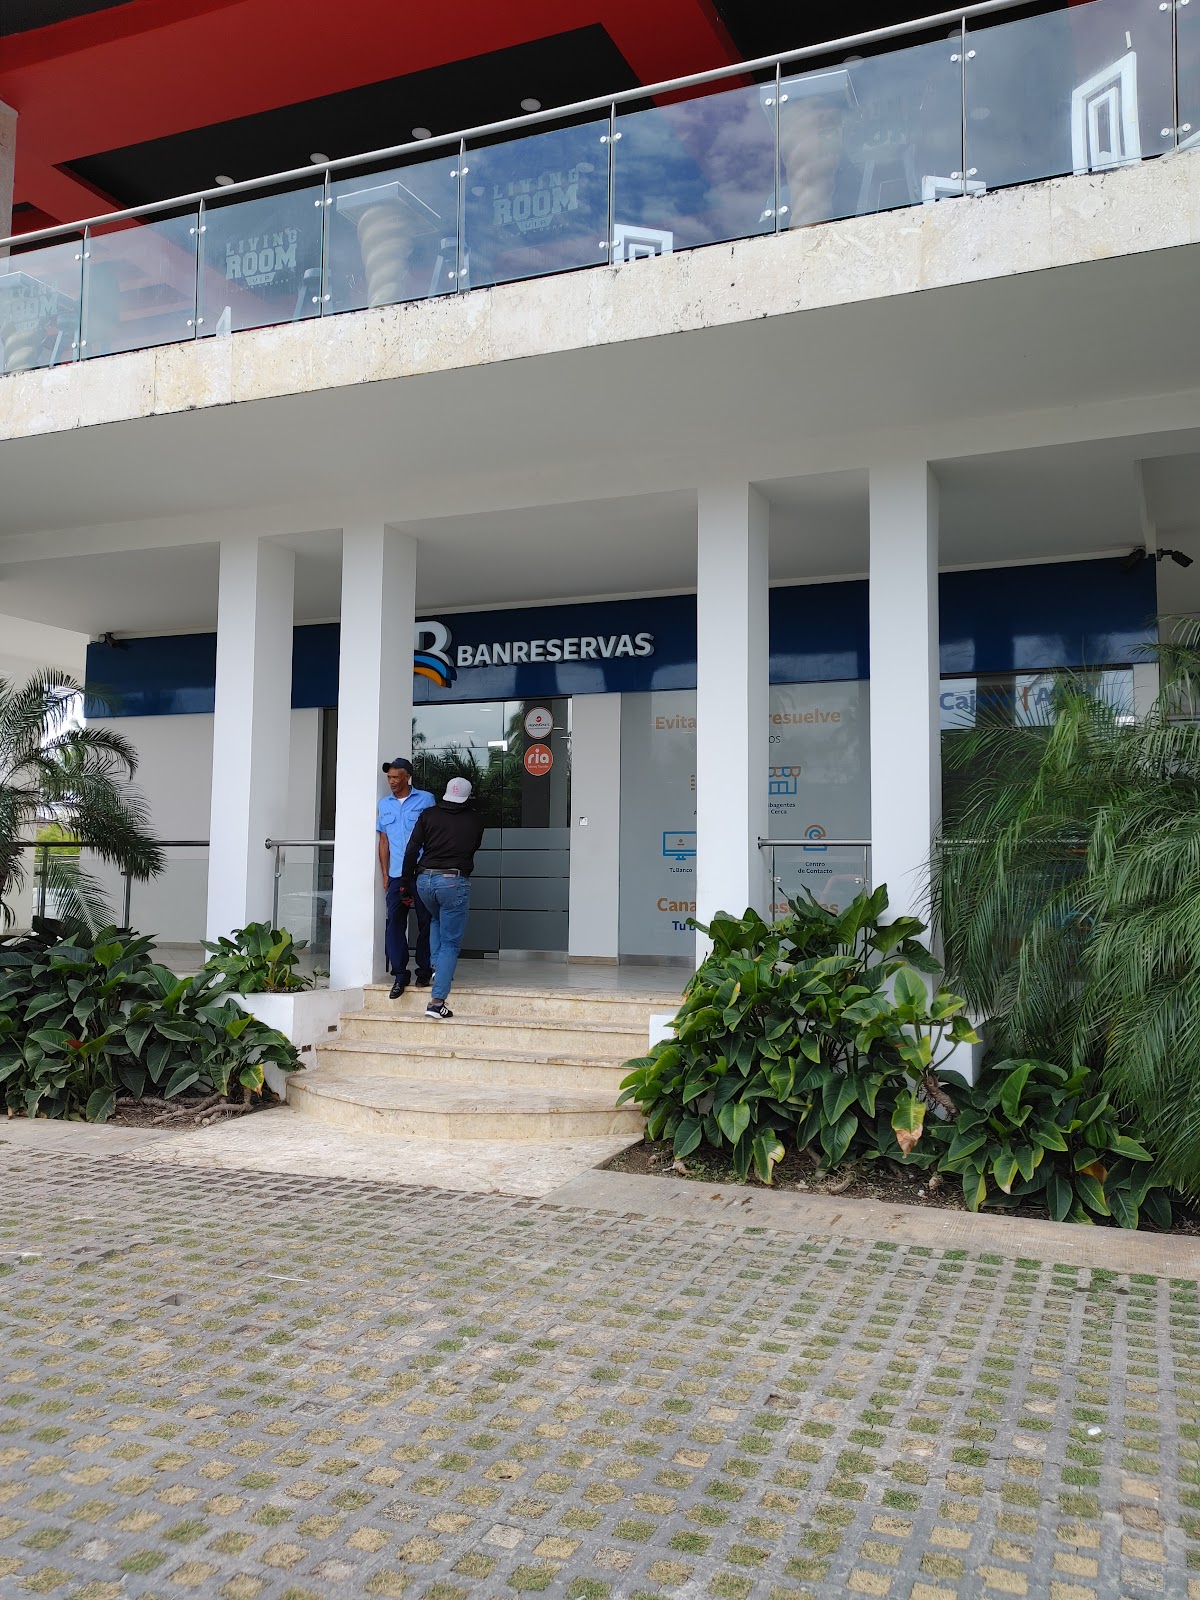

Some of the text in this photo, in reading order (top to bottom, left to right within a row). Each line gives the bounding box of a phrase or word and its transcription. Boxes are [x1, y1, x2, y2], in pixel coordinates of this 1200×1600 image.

[493, 168, 579, 200] LIVING
[493, 184, 579, 226] ROOM
[226, 229, 298, 256] LIVING
[226, 243, 298, 281] ROOM
[457, 633, 654, 667] BANRESERVAS
[655, 714, 697, 730] Evita
[527, 748, 550, 764] ria
[768, 802, 796, 810] bagentes
[657, 897, 697, 912] Cana
[672, 920, 687, 931] Tu
